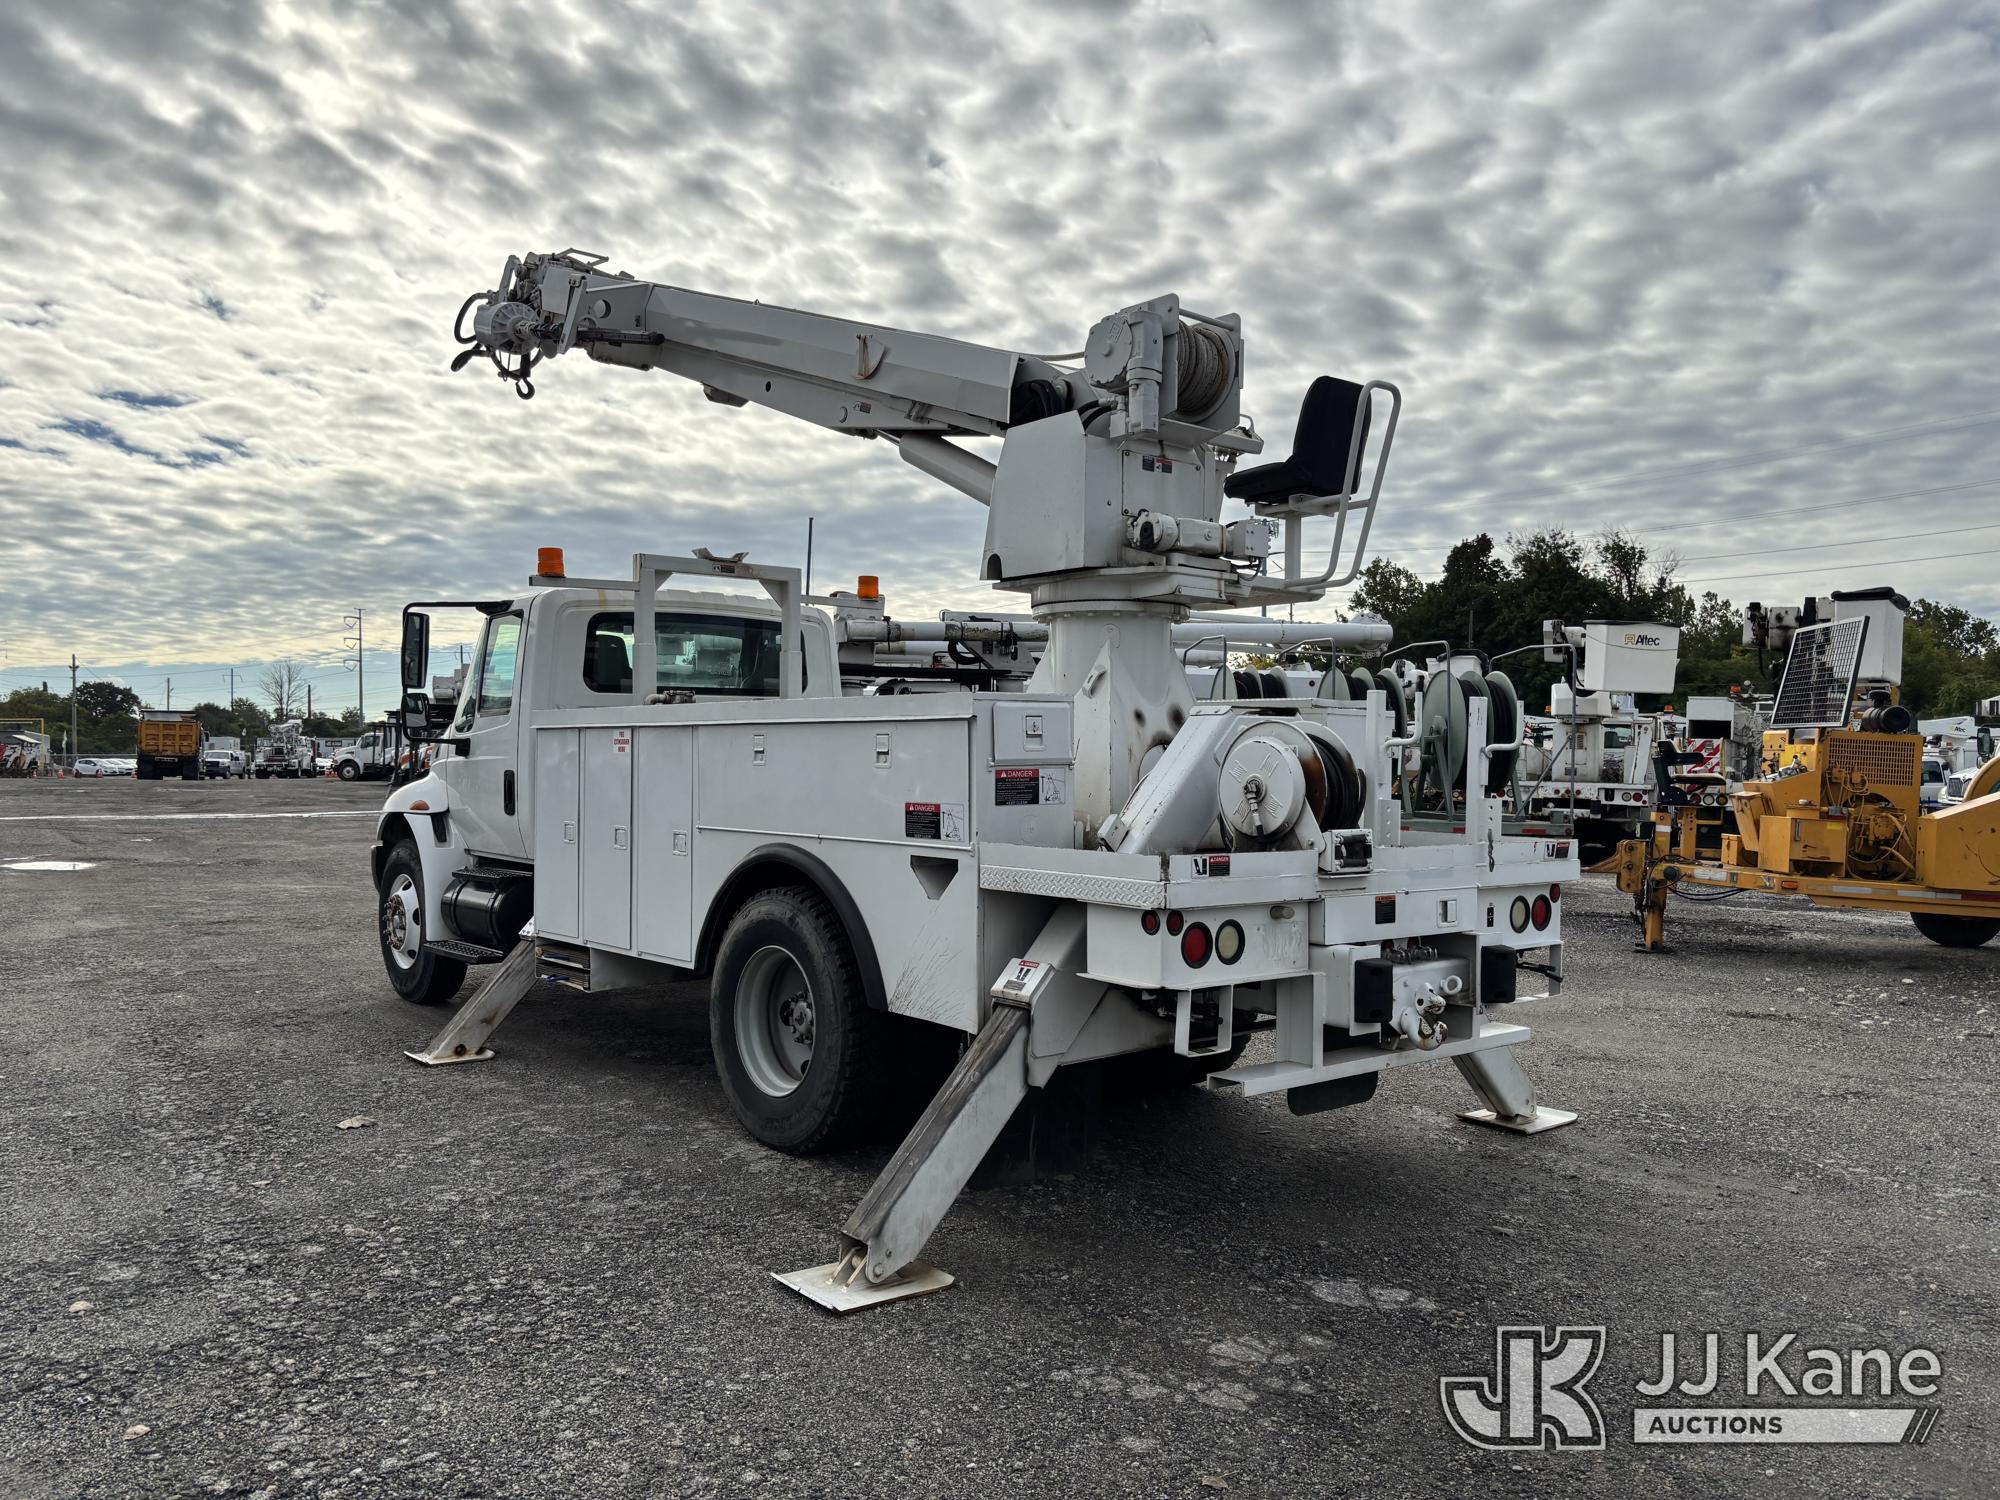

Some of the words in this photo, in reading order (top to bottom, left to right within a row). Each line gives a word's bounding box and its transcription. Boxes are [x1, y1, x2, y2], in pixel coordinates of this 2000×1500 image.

[1635, 634, 1660, 646] Altec
[1007, 770, 1033, 778] DANGER
[914, 804, 935, 812] DANGER
